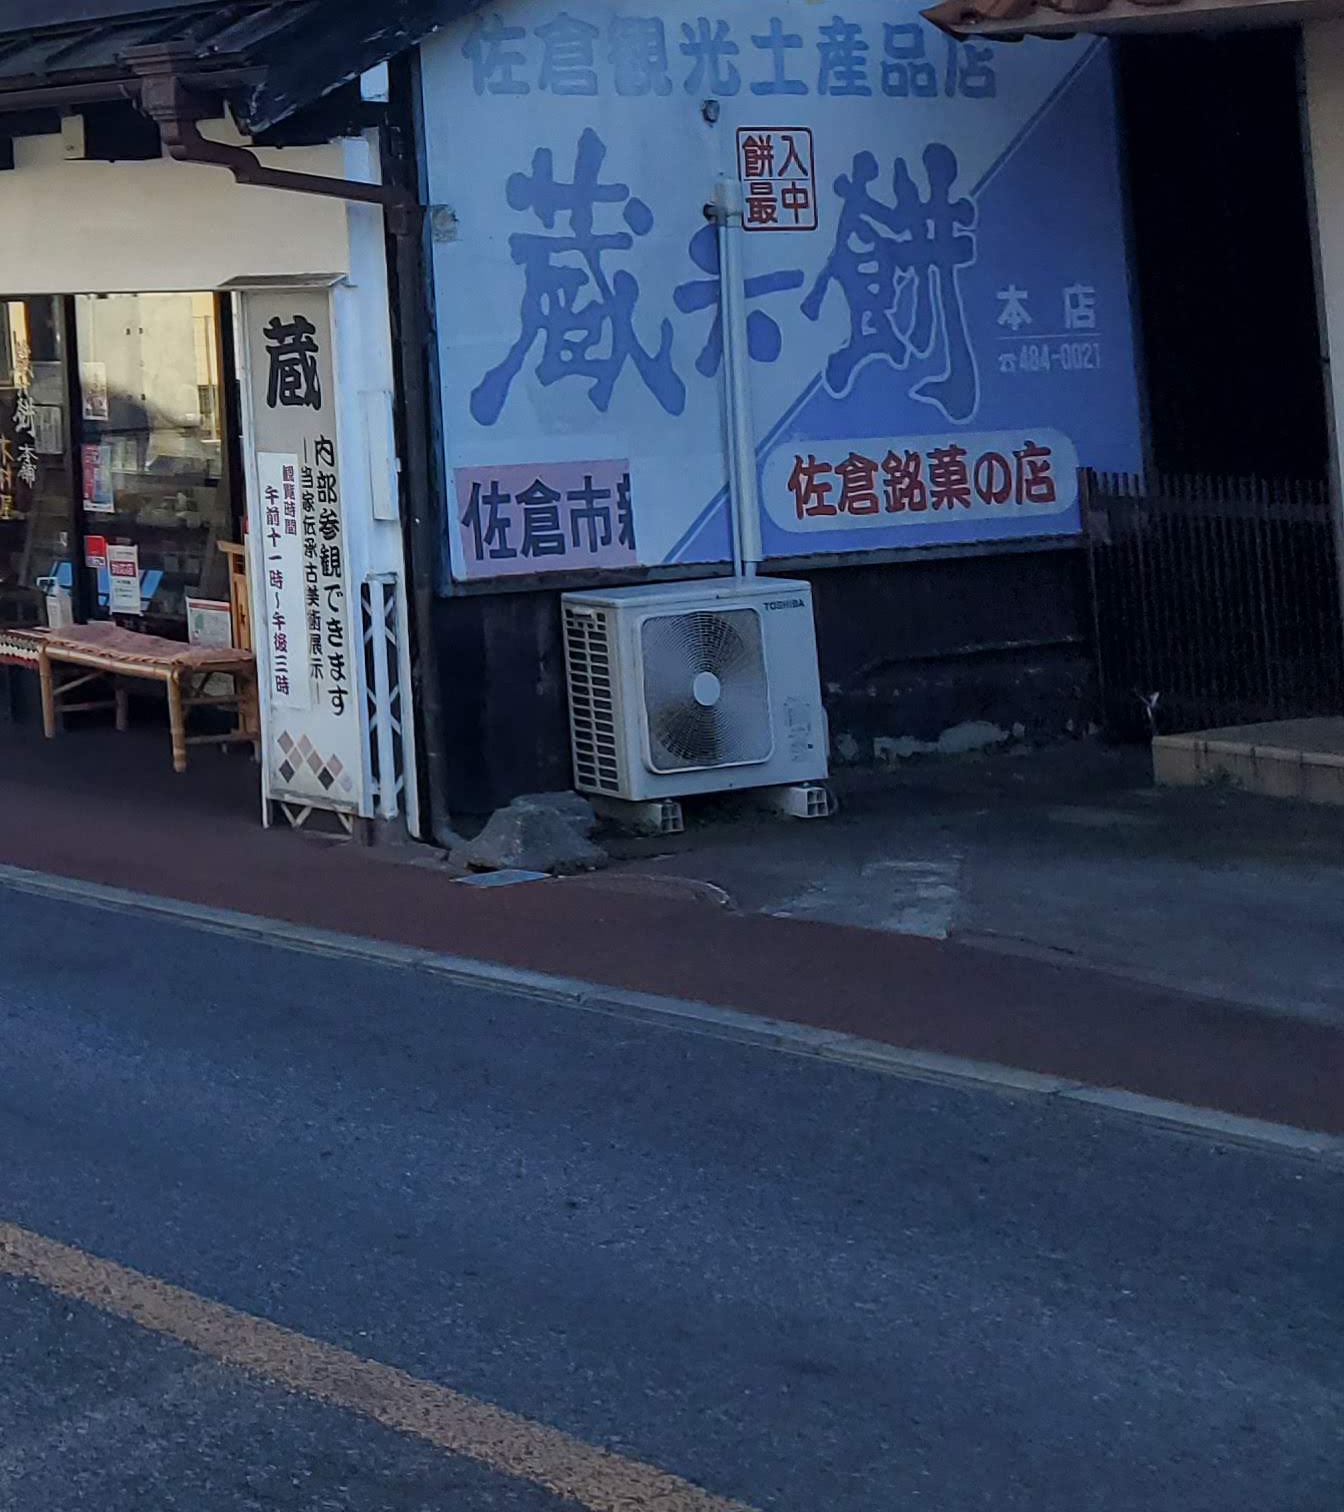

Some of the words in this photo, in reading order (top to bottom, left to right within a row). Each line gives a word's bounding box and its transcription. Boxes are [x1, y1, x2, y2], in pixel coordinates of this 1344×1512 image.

[461, 10, 997, 98] 佐倉観光土産品店
[263, 315, 322, 411] 蔵
[788, 440, 1056, 520] 佐倉銘菓の店
[314, 434, 348, 716] 内部参観できます
[763, 598, 805, 611] TOSHIBA
